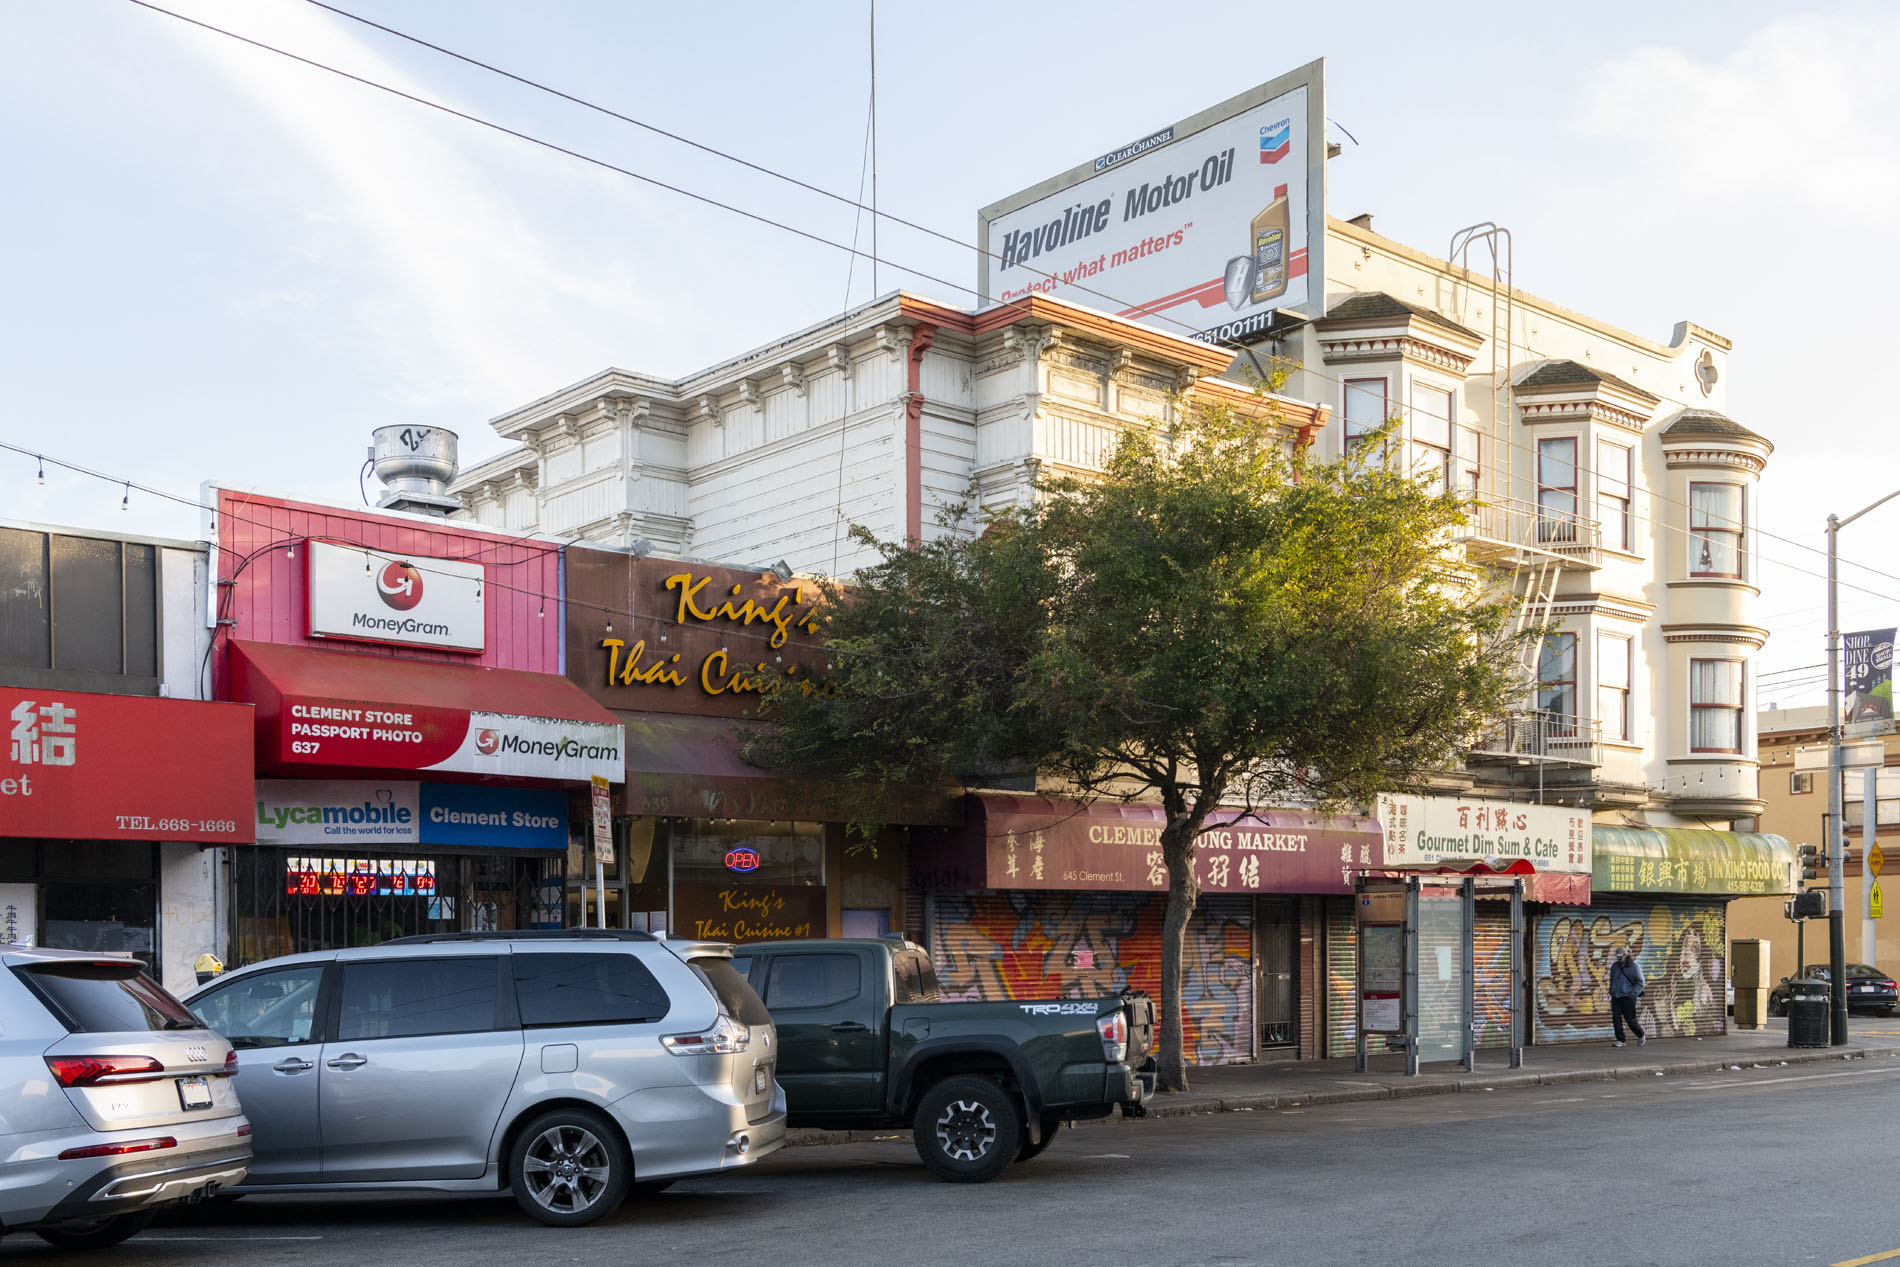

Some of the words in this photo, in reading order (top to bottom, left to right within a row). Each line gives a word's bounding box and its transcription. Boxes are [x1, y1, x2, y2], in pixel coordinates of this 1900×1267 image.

[1260, 118, 1290, 135] Chevron
[1000, 198, 1112, 272] Havoline
[1123, 169, 1199, 223] Motor
[1199, 147, 1235, 192] Oil
[1063, 254, 1106, 286] what
[352, 612, 450, 636] MoneyGram
[1846, 635, 1870, 649] SHOP
[602, 639, 689, 687] Thai
[1846, 648, 1869, 664] DINE
[1846, 663, 1869, 680] 49
[291, 705, 362, 722] CLEMENT
[365, 711, 413, 726] STORE
[291, 723, 370, 739] PASSPORT
[373, 729, 423, 743] PHOTO
[291, 741, 320, 754] 637
[501, 733, 619, 761] MoneyGram
[115, 816, 236, 832] TEL.668-1666
[257, 801, 412, 829] Lycamobile
[430, 806, 509, 829] Clement
[512, 811, 559, 830] Store
[1456, 806, 1528, 832] 百利點心
[324, 826, 341, 835] Call
[343, 827, 357, 835] the
[359, 826, 382, 835] world
[383, 826, 395, 835] for
[396, 826, 413, 835] less
[1192, 831, 1233, 850] UNG
[1237, 832, 1308, 853] MARKET
[1416, 830, 1469, 853] Gourmet
[1472, 834, 1495, 855] Dim
[1497, 837, 1520, 856] Sum
[1523, 837, 1531, 856] &
[1534, 838, 1558, 858] Cafe
[724, 851, 760, 869] OPEN
[1707, 859, 1723, 879] YIN
[1725, 859, 1746, 880] XING
[1747, 861, 1770, 880] FOOD
[1062, 870, 1078, 881] 645
[1079, 870, 1113, 882] Clement
[1114, 871, 1125, 883] St.
[718, 889, 785, 917] King's
[695, 920, 729, 938] Thai
[733, 921, 793, 939] Cuisine
[794, 923, 810, 937] #1
[1019, 1004, 1060, 1016] TRD
